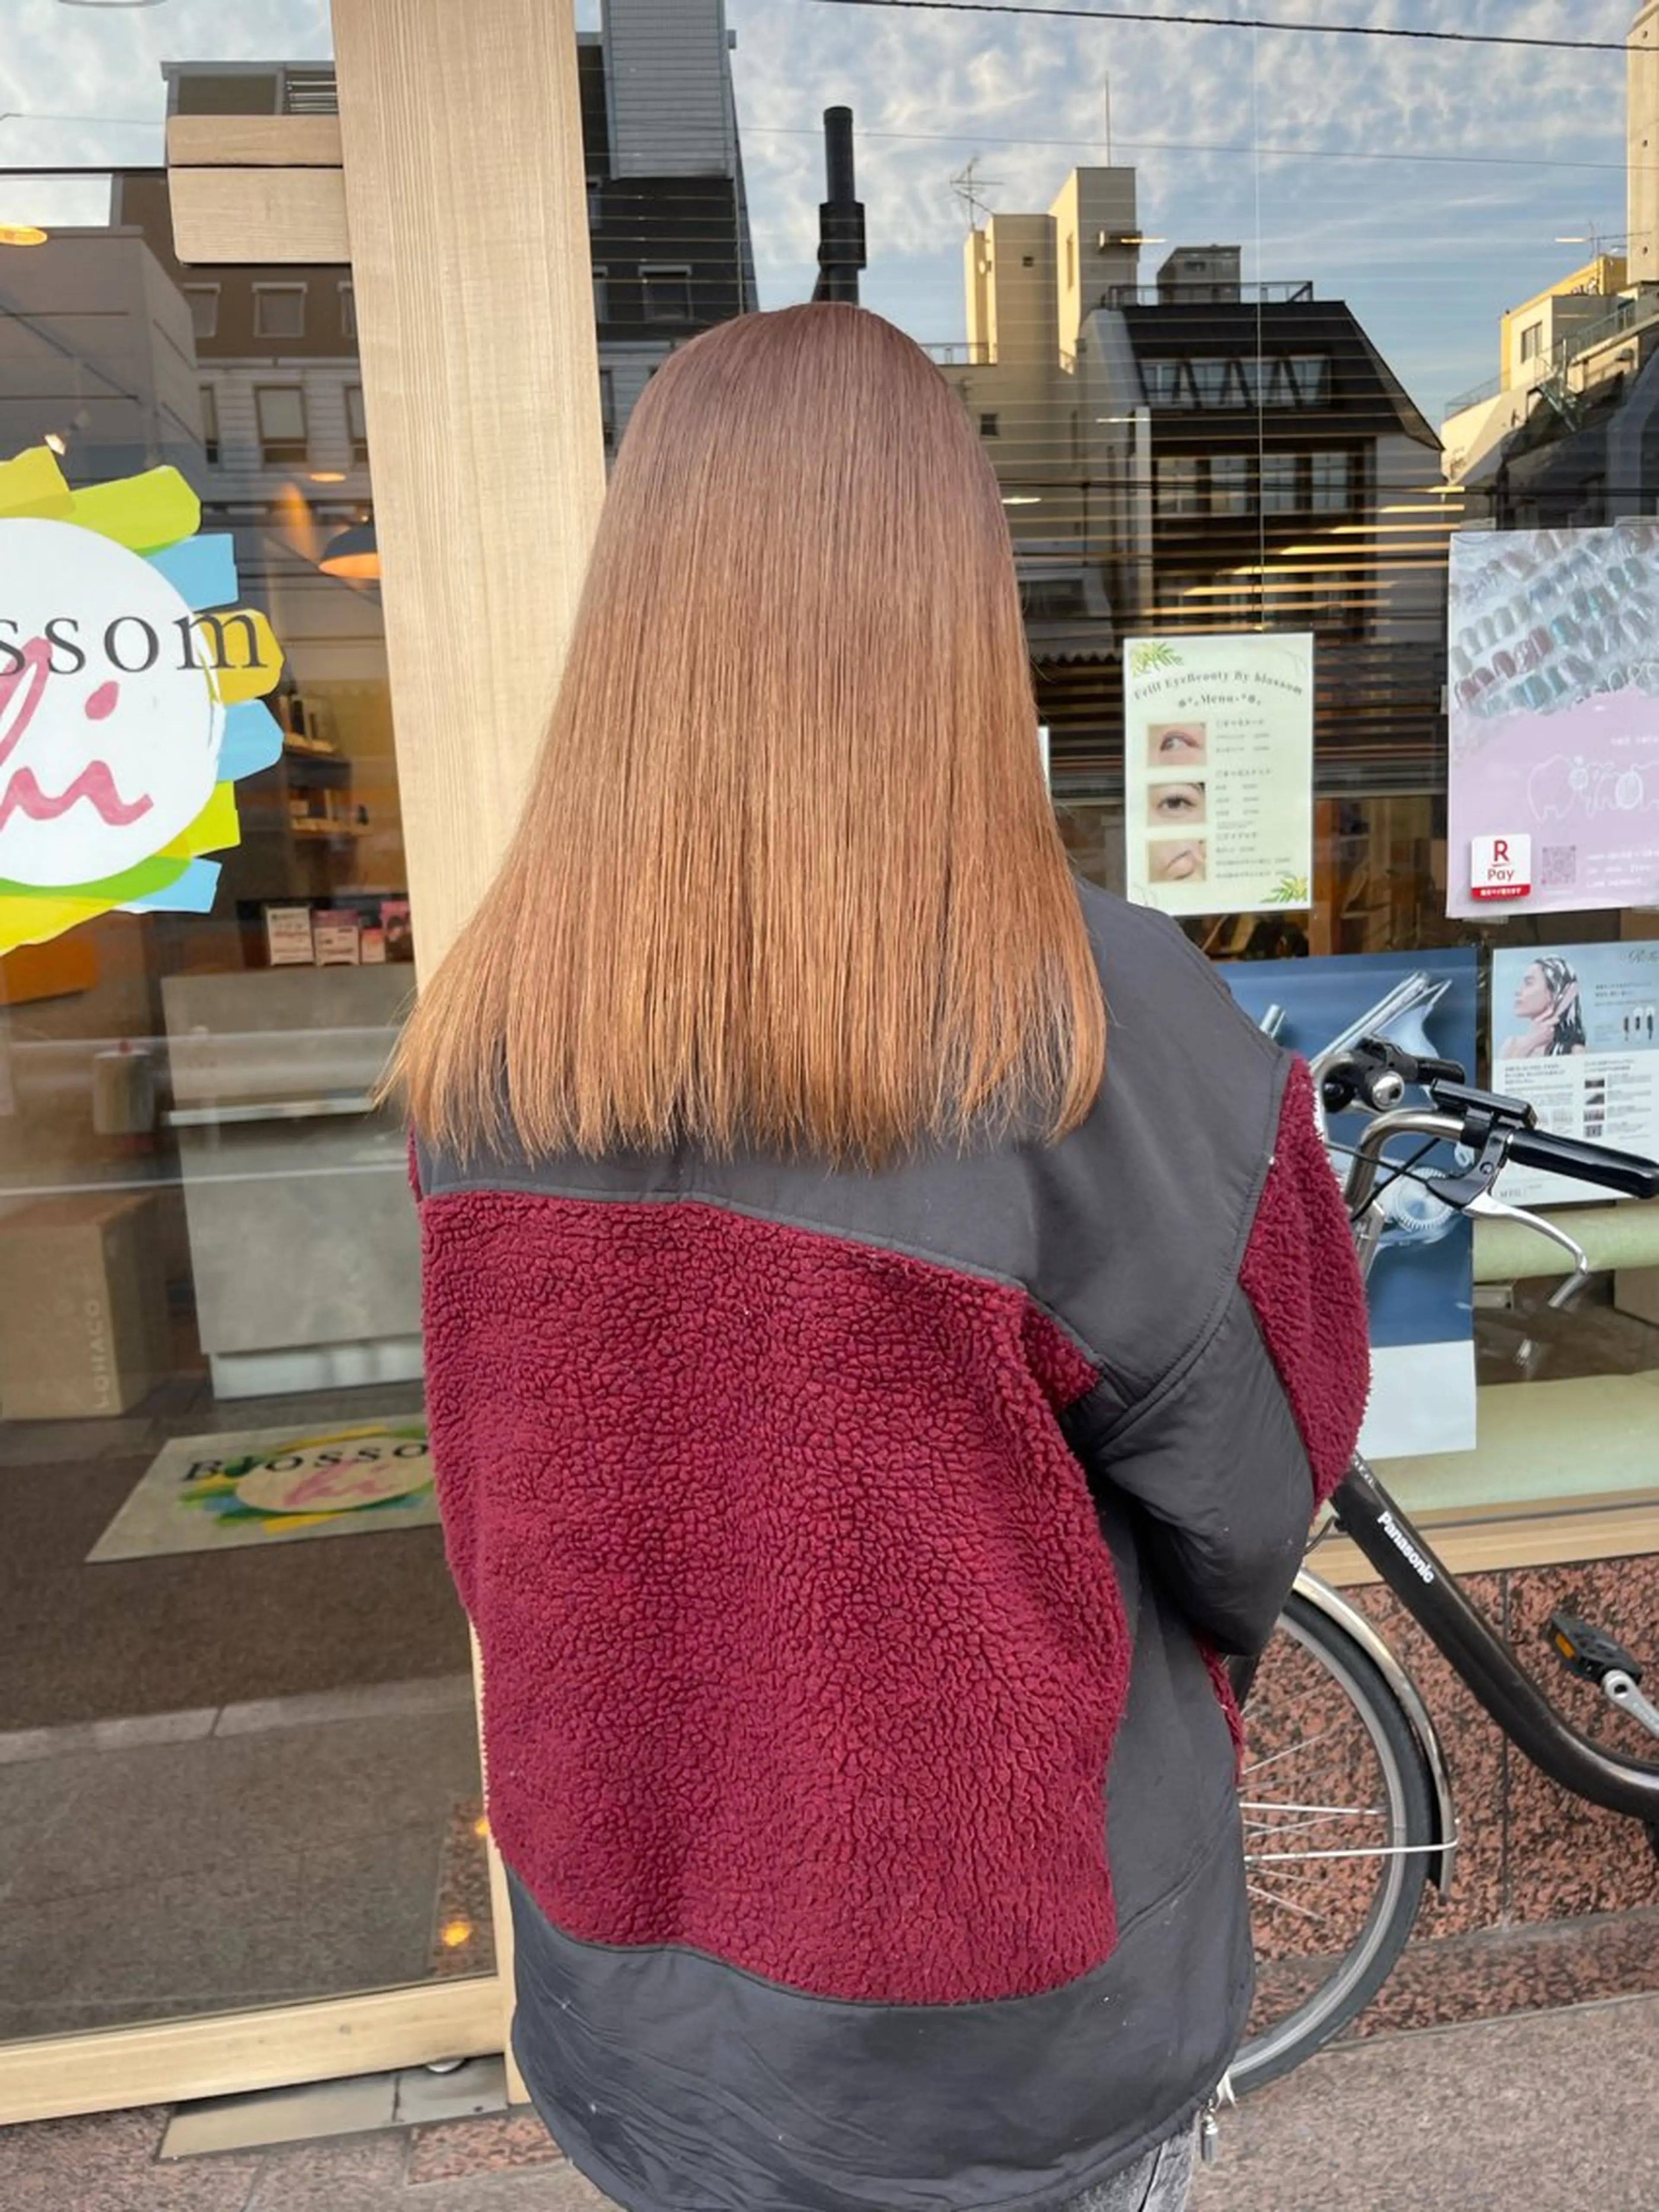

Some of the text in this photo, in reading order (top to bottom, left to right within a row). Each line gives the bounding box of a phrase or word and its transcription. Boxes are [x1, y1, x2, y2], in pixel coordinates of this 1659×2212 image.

[1494, 840, 1510, 861] R
[1487, 868, 1515, 883] Pay
[1377, 1510, 1434, 1583] Panasonic
